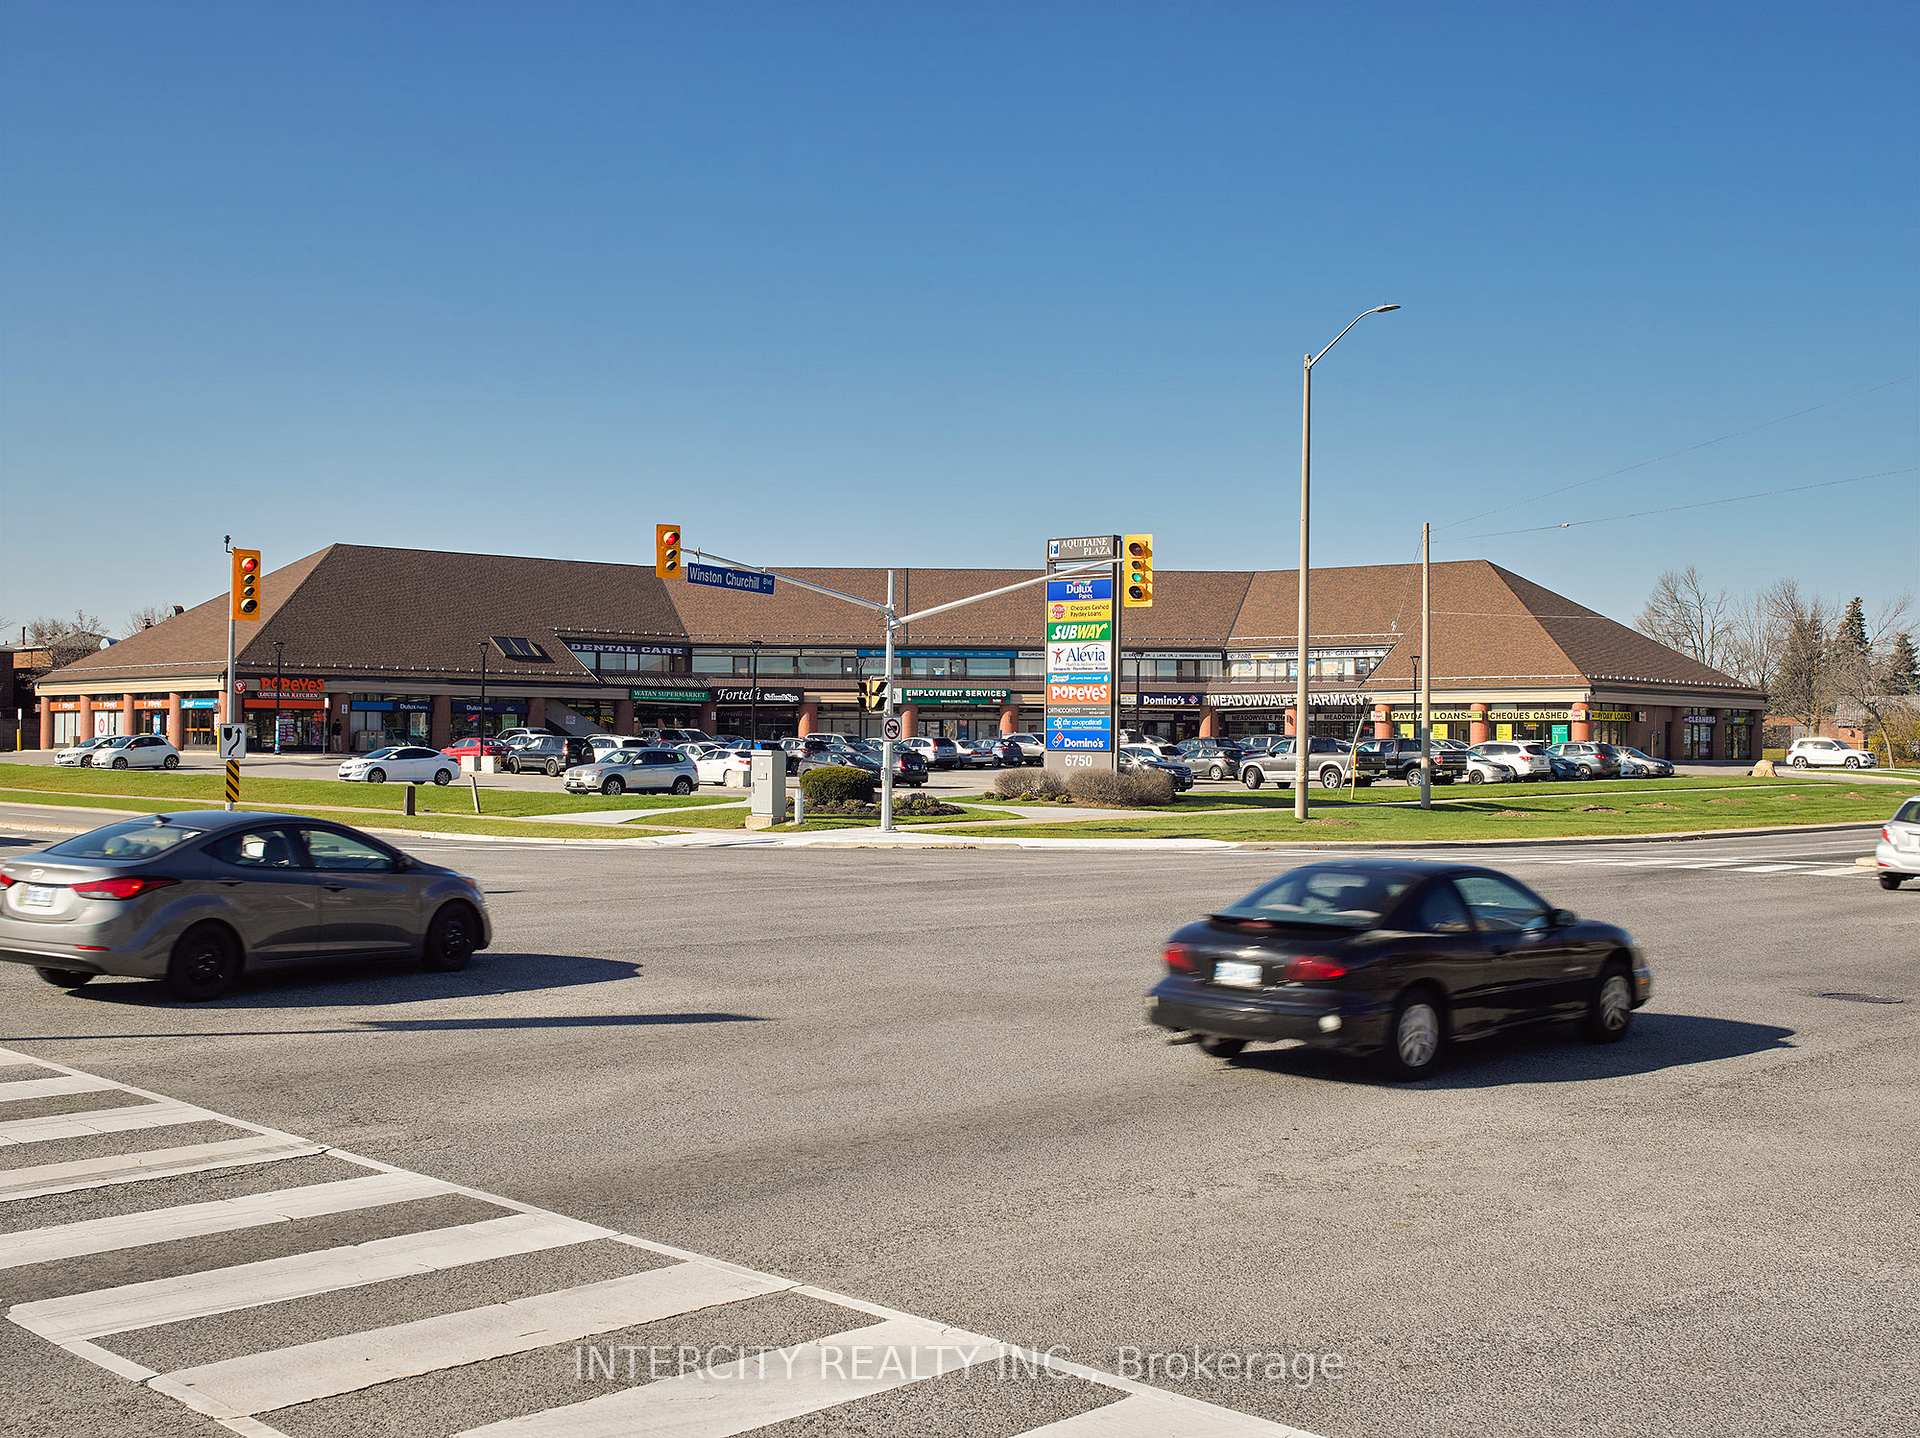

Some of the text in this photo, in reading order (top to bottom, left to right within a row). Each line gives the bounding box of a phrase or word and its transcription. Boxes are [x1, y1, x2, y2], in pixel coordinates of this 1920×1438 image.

[1061, 537, 1107, 549] AQUITAINE
[1083, 545, 1111, 556] PLAZA
[689, 566, 722, 585] Winston
[726, 572, 760, 590] Churchill
[1066, 583, 1093, 594] Dulux
[1051, 623, 1108, 640] SUBWAY
[571, 643, 684, 655] DENTAL CARE
[716, 687, 762, 702] Forteli
[906, 689, 1007, 697] EMPLOYMENT SERVICES
[1143, 695, 1185, 705] Domino's
[1210, 692, 1366, 706] MEADOWVALE HARMACY
[1434, 711, 1466, 720] LOANS
[1490, 712, 1530, 720] CHEQUES
[1534, 712, 1569, 720] CASHED
[1689, 716, 1716, 724] CLEANERS
[1064, 738, 1104, 748] Domino's
[1065, 755, 1093, 767] 6750
